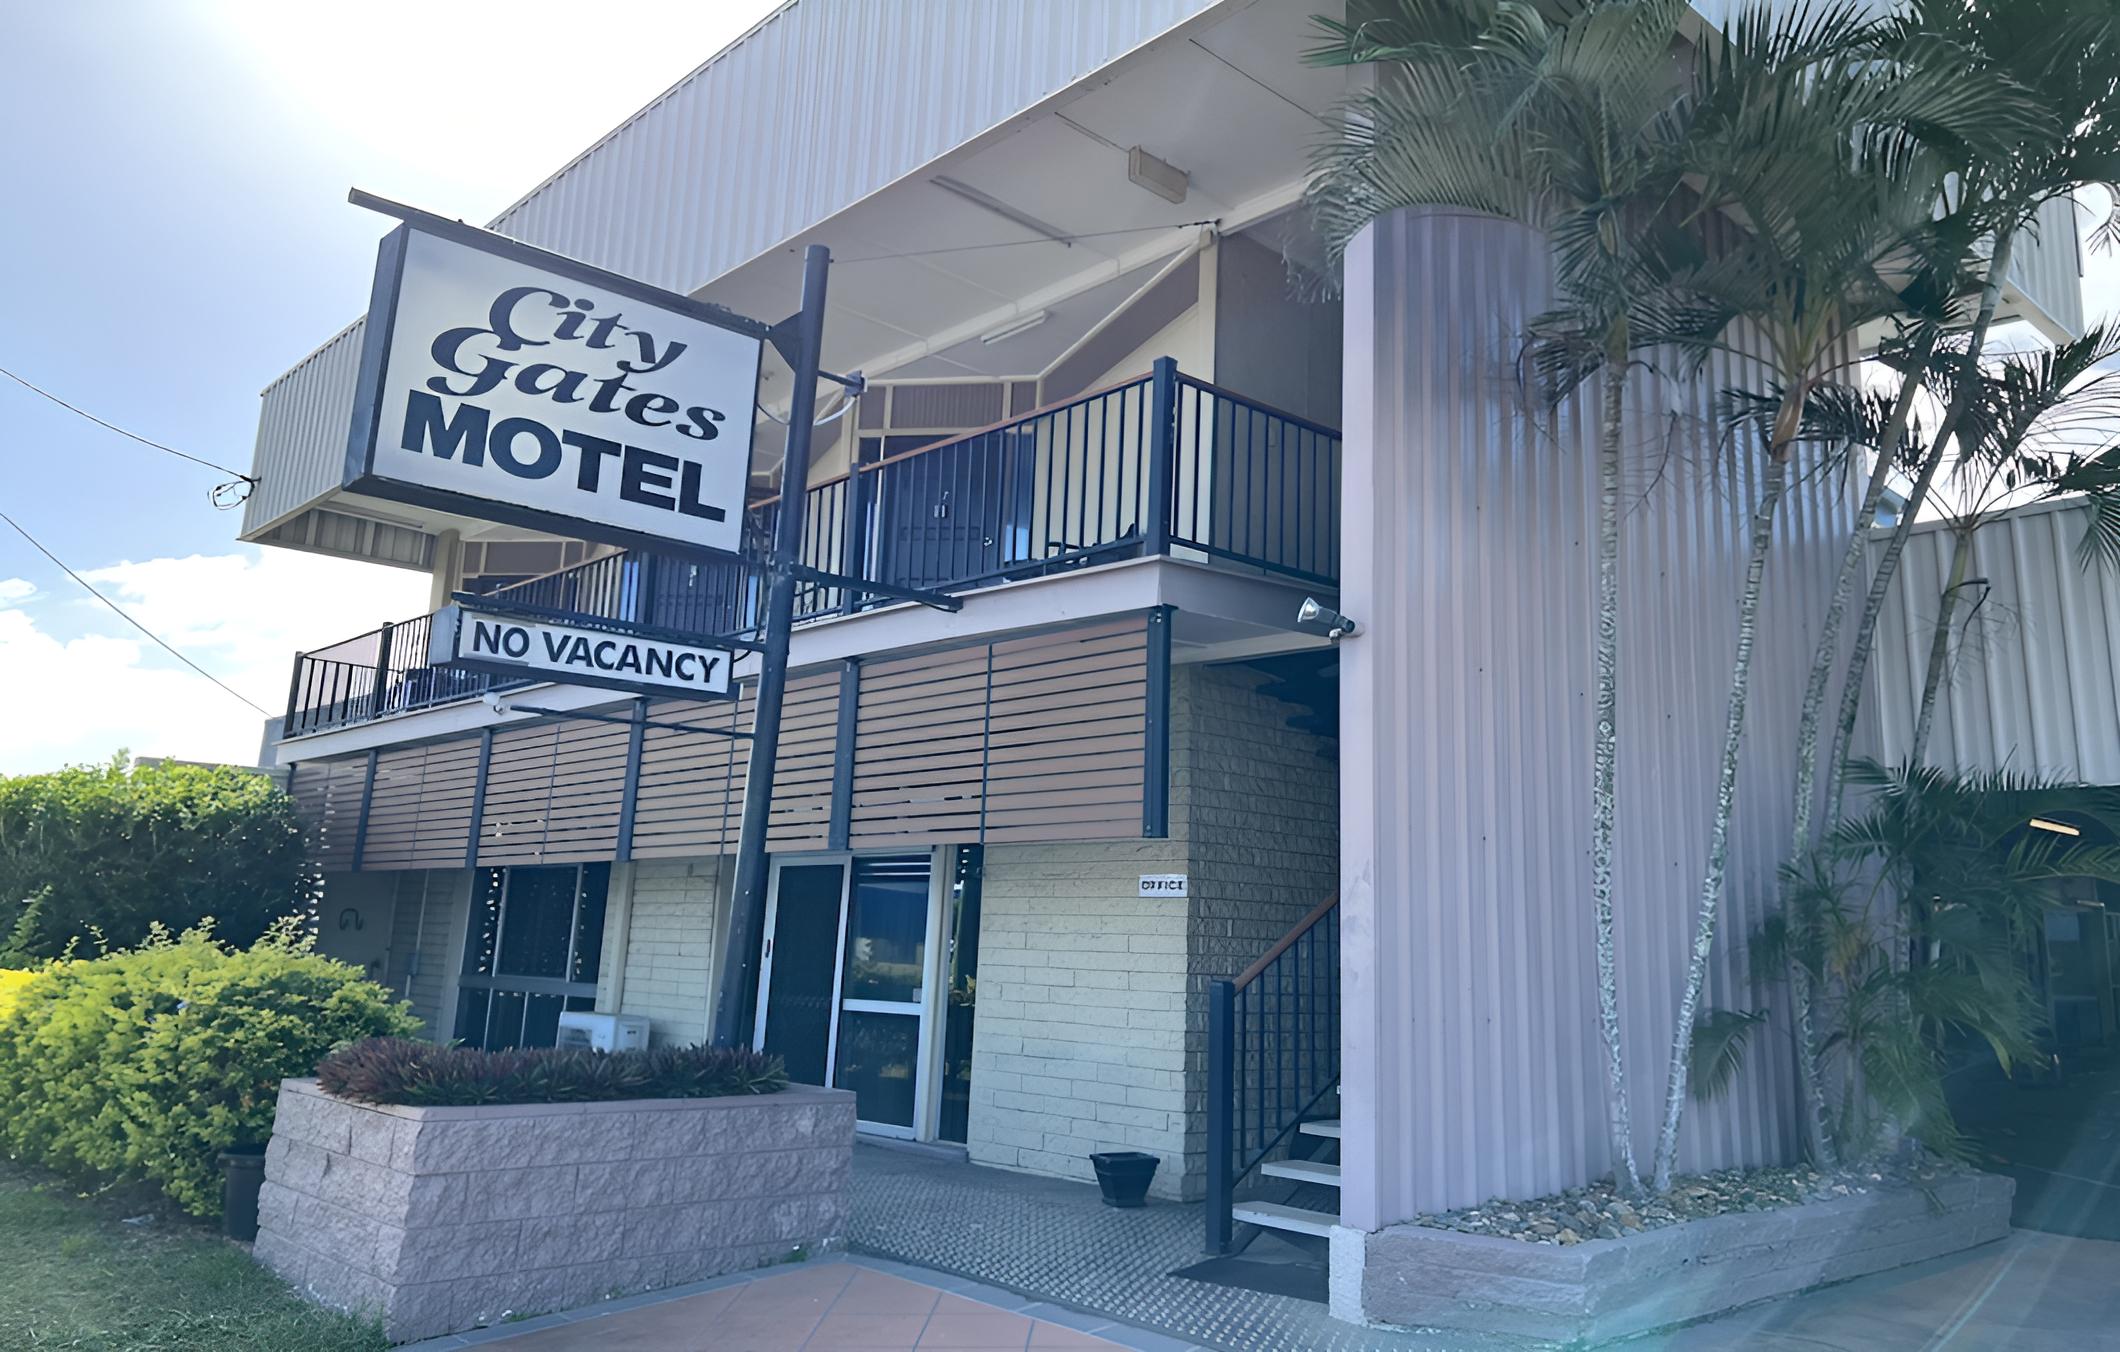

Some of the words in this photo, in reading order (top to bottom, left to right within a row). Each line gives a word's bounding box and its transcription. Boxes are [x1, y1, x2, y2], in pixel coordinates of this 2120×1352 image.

[489, 286, 687, 373] City
[426, 327, 726, 440] Gates
[400, 389, 726, 522] MOTEL
[472, 620, 530, 658] NO
[543, 631, 720, 683] VACANCY
